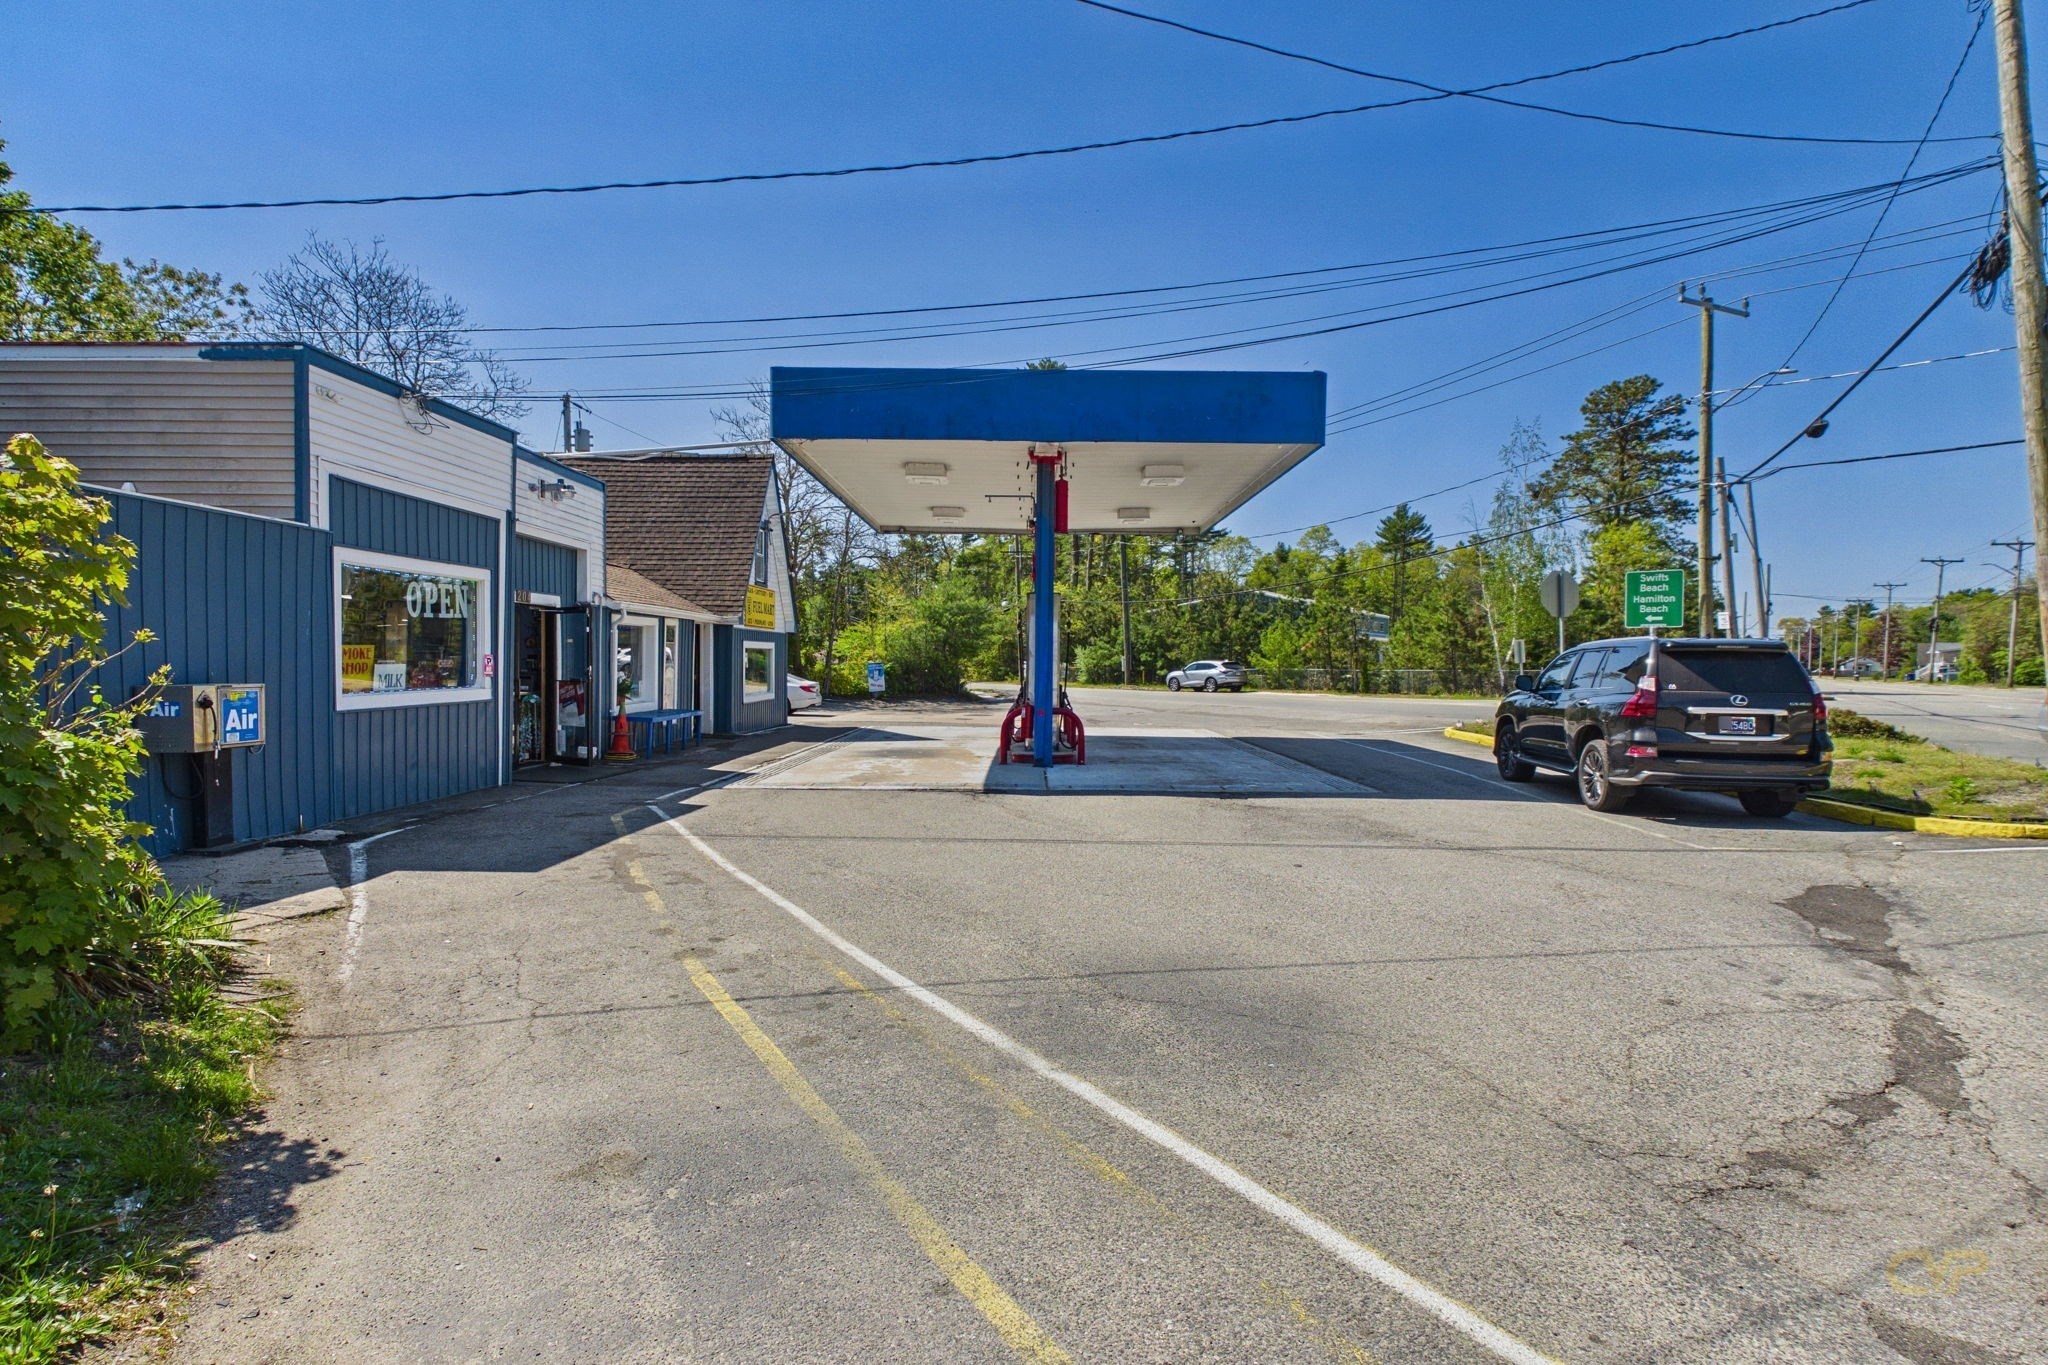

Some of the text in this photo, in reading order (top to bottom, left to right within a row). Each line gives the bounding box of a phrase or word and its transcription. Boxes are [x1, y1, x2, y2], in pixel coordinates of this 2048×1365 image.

[1640, 574, 1669, 582] Swifts
[1640, 583, 1669, 592] Beach
[406, 581, 469, 619] OPEN
[1633, 595, 1676, 604] Hamilton
[1640, 605, 1668, 613] Beach
[342, 647, 372, 660] MOKE
[378, 673, 403, 689] MILK
[150, 702, 179, 717] Air
[226, 708, 258, 731] Air
